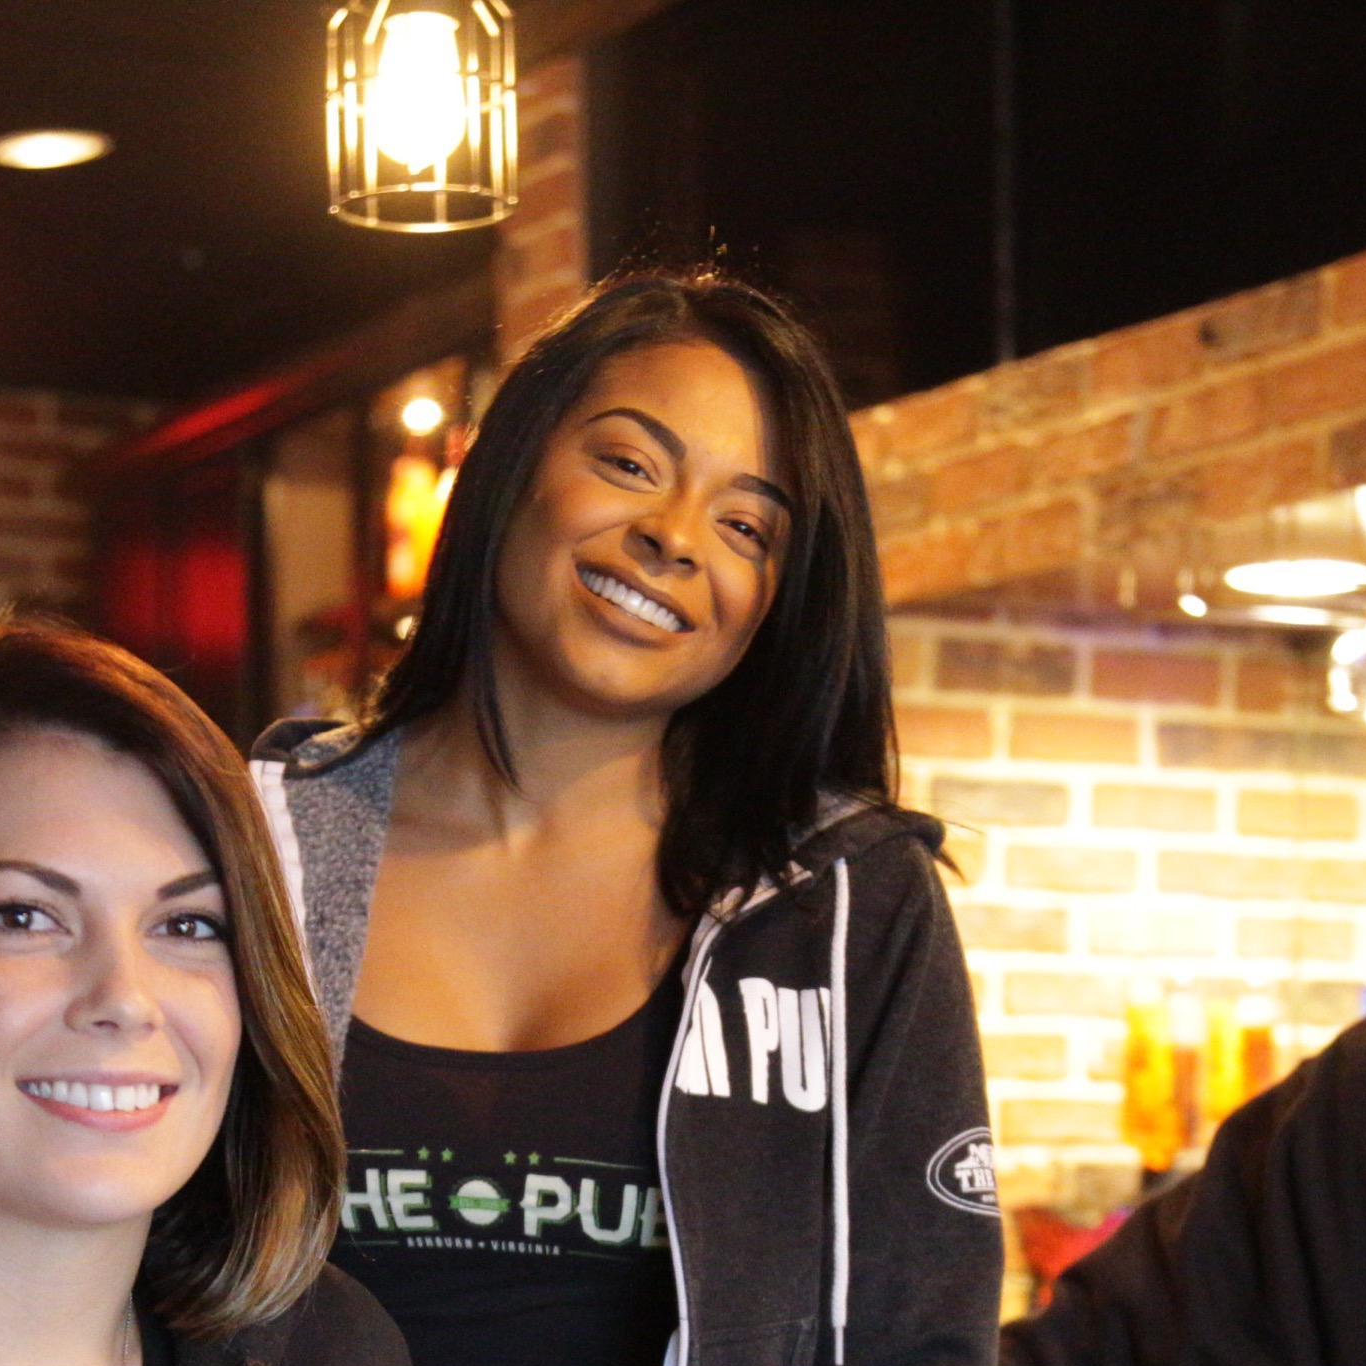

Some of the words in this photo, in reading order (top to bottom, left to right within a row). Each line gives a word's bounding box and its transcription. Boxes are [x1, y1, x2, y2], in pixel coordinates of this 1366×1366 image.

[738, 977, 831, 1113] PU
[341, 1168, 435, 1231] HE
[407, 1236, 473, 1249] ASHBURN
[491, 1240, 560, 1256] VIRGINIA
